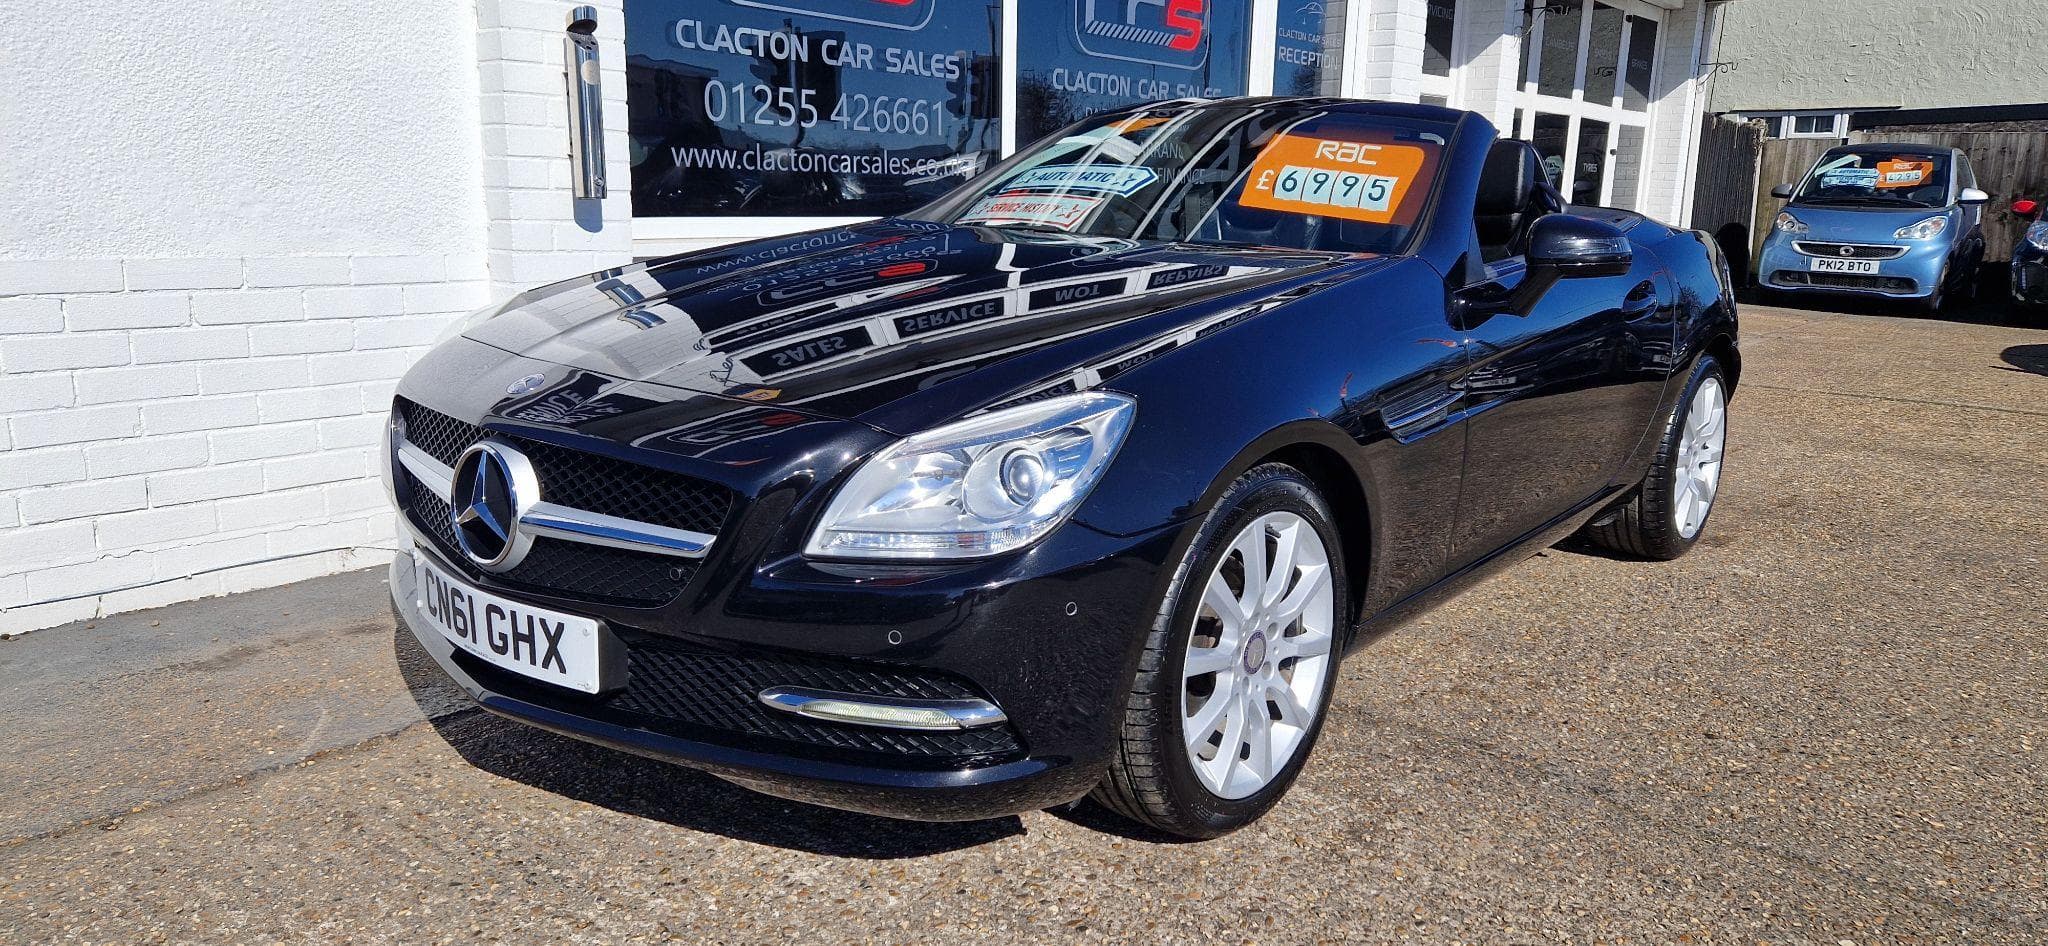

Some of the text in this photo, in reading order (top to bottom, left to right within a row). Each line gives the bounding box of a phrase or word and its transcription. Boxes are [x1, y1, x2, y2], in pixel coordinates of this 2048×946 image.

[675, 18, 960, 80] CLACTON CAR SALES
[1279, 28, 1307, 42] CLACTON
[1307, 33, 1321, 44] CAR
[1278, 46, 1339, 70] RECEPTION
[1052, 67, 1131, 97] CLACTON
[1137, 78, 1171, 101] CAR
[703, 80, 944, 136] 01255 426661
[671, 143, 967, 178] www.clactoncarsales.co.uk
[1036, 171, 1114, 183] AUTOMATIC
[1818, 260, 1871, 272] PK12 BTO
[425, 567, 567, 675] CN61 GHX
